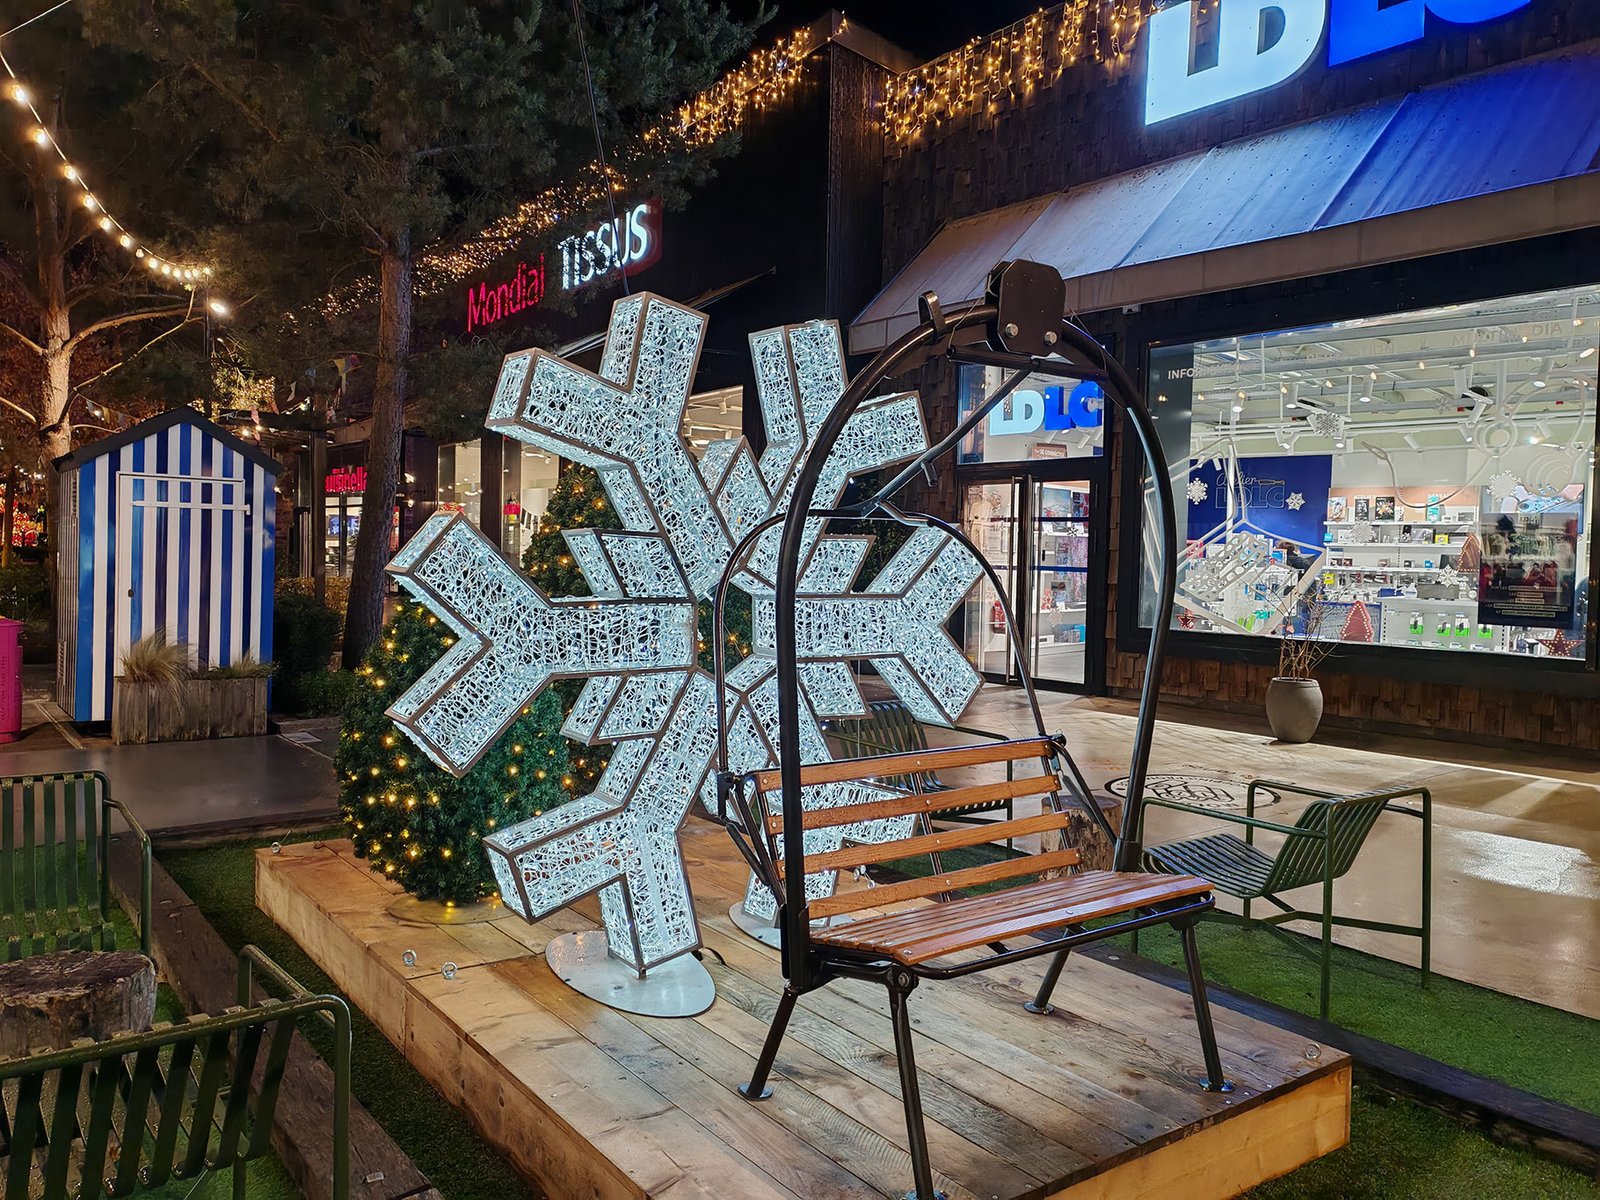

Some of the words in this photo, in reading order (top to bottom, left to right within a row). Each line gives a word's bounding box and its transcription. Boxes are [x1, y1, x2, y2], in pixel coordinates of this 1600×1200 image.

[1145, 0, 1531, 125] LDL
[467, 251, 545, 333] Mondial
[556, 203, 652, 290] TISSUS
[989, 380, 1104, 437] LDLC
[324, 466, 368, 493] uisinell
[1215, 486, 1286, 509] LDLC
[1216, 472, 1258, 487] Aelier
